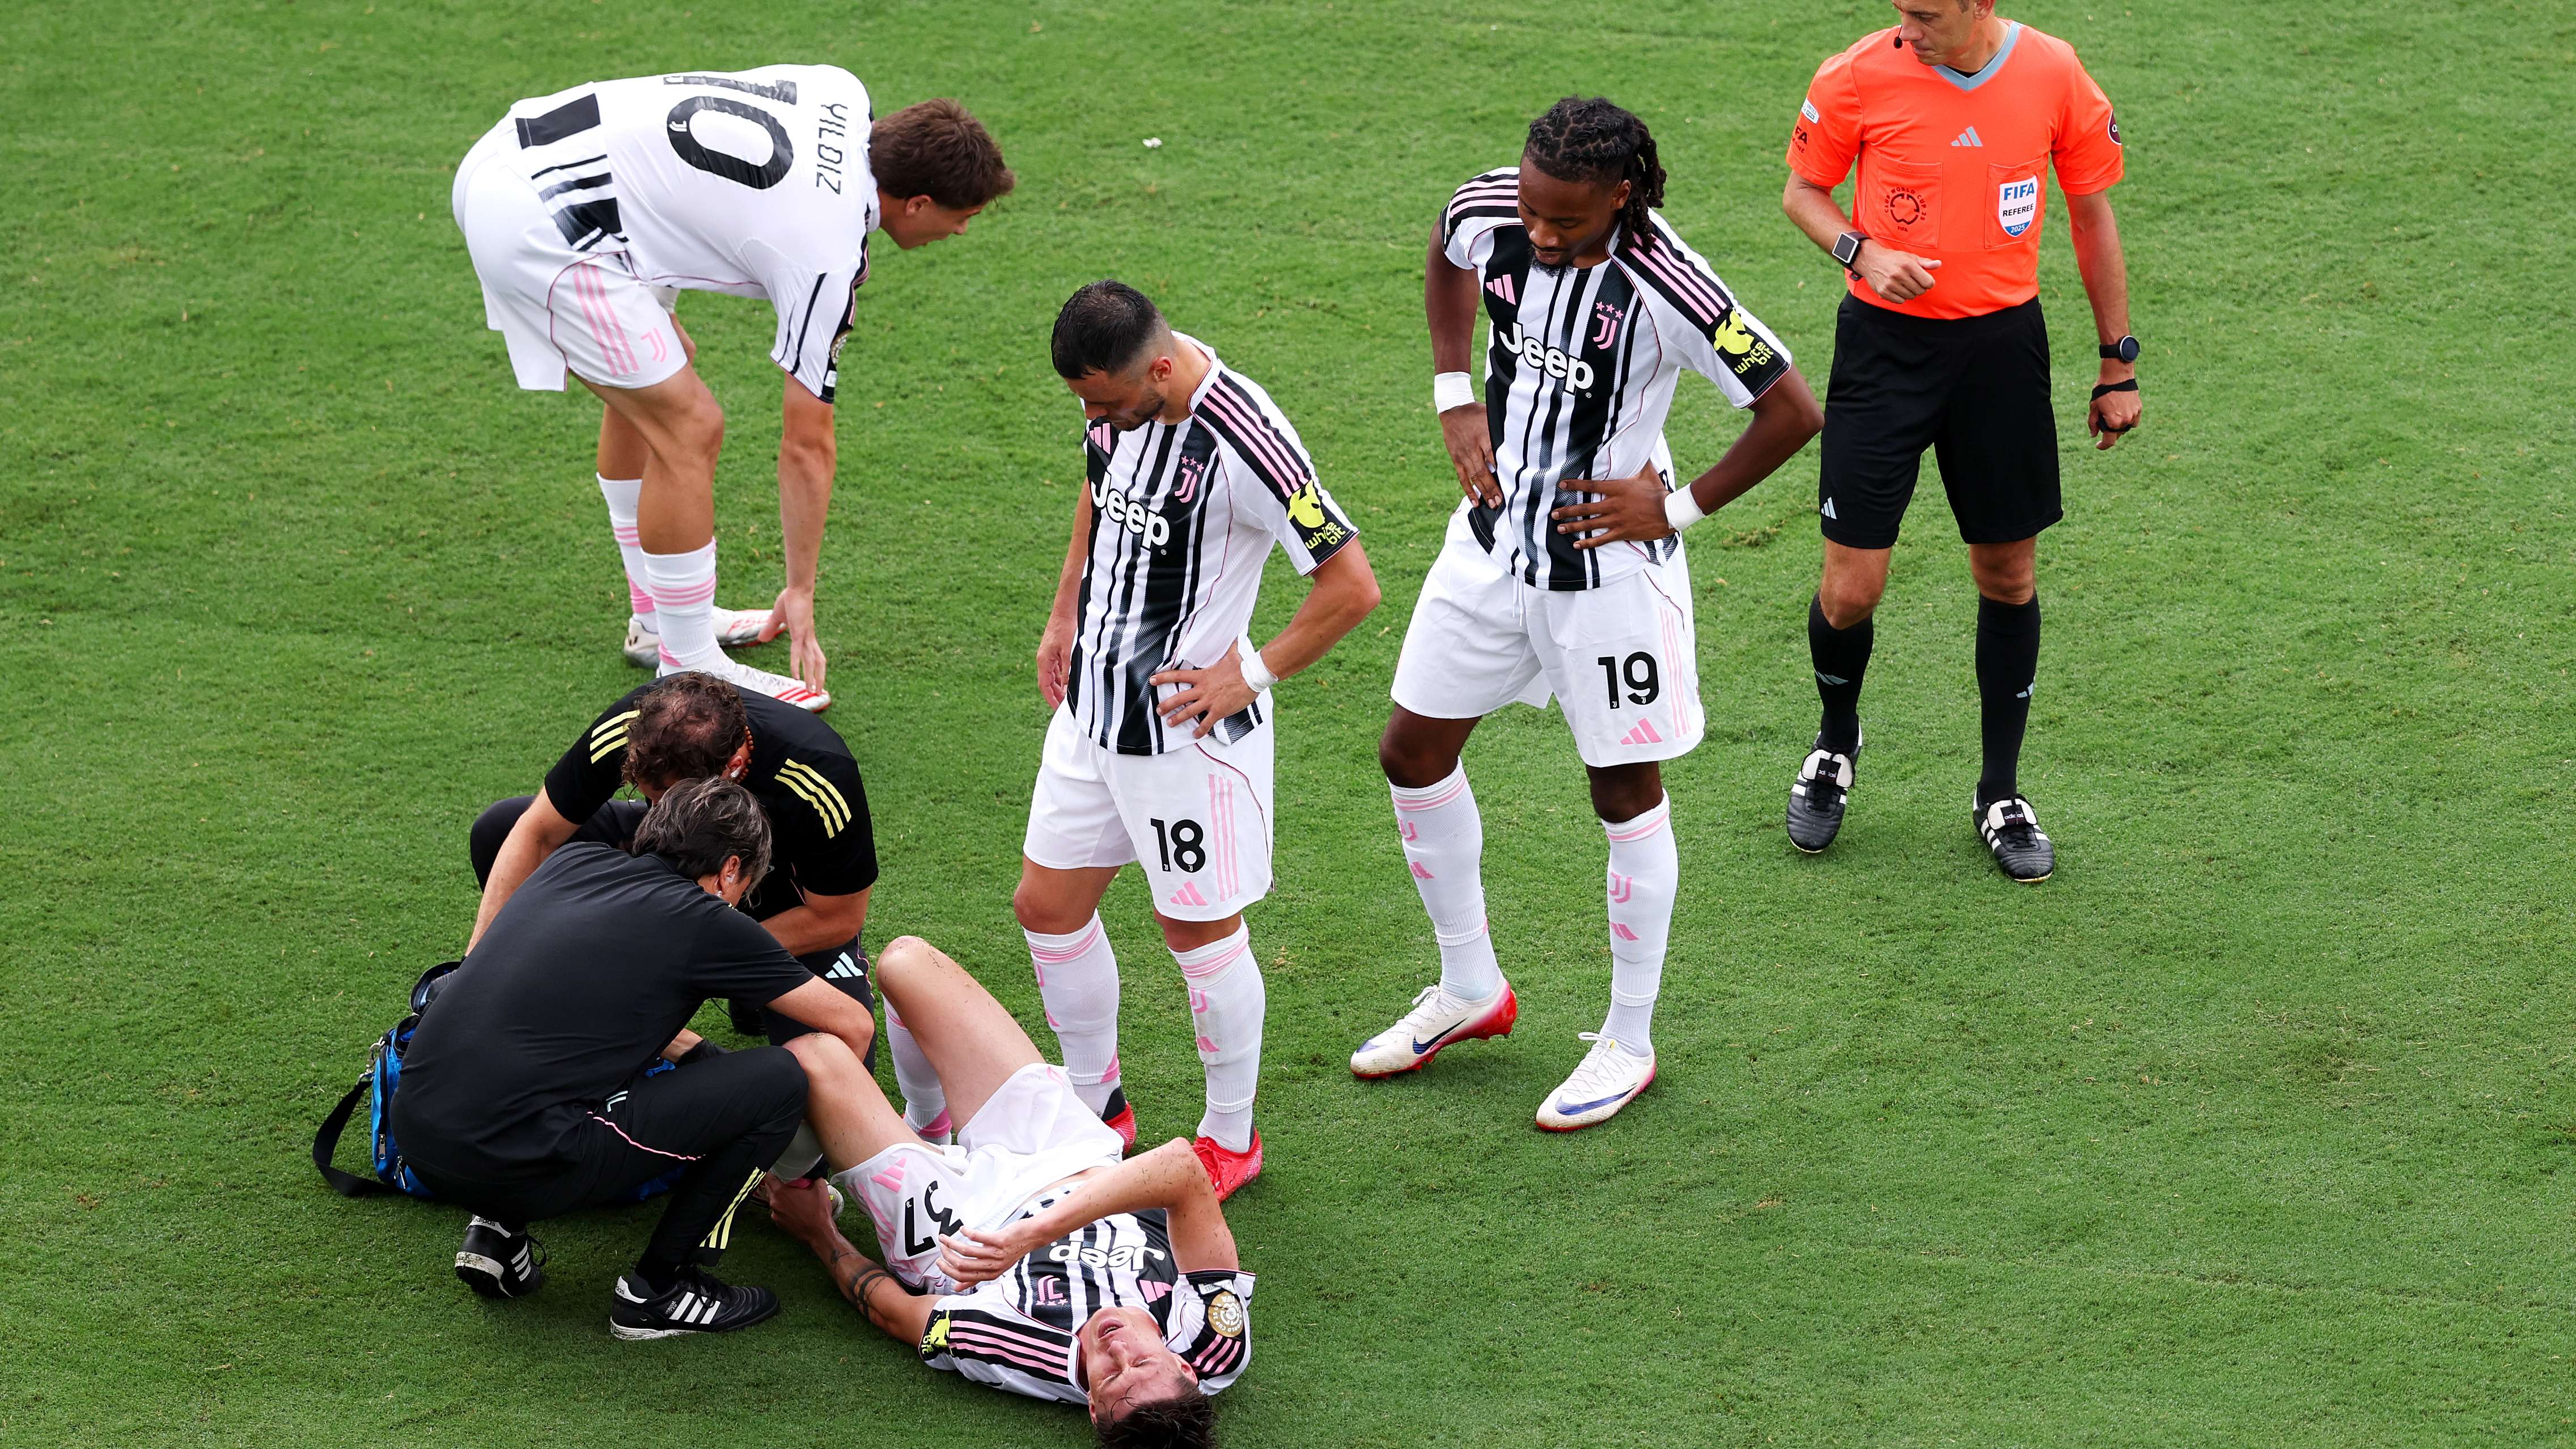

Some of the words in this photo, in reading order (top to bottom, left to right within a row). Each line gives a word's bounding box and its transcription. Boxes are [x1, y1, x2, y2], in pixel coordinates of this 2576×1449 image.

[663, 75, 798, 190] 10
[816, 103, 849, 196] YILDIZ
[1917, 194, 1926, 208] CUP
[2003, 182, 2035, 201] FIFA
[2002, 203, 2034, 217] REFEREE
[2010, 223, 2026, 234] 2025
[1499, 321, 1594, 393] Jeep
[1734, 341, 1766, 374] white
[1751, 348, 1774, 366] bit
[1091, 471, 1170, 549] Jeep
[1326, 527, 1346, 545] bit
[1598, 651, 1660, 710] 19
[1150, 817, 1206, 874] 18
[904, 1180, 964, 1257] 37
[1048, 1241, 1166, 1271] Jeep
[1215, 1321, 1226, 1331] CUP
[1227, 1320, 1243, 1332] WORLD
